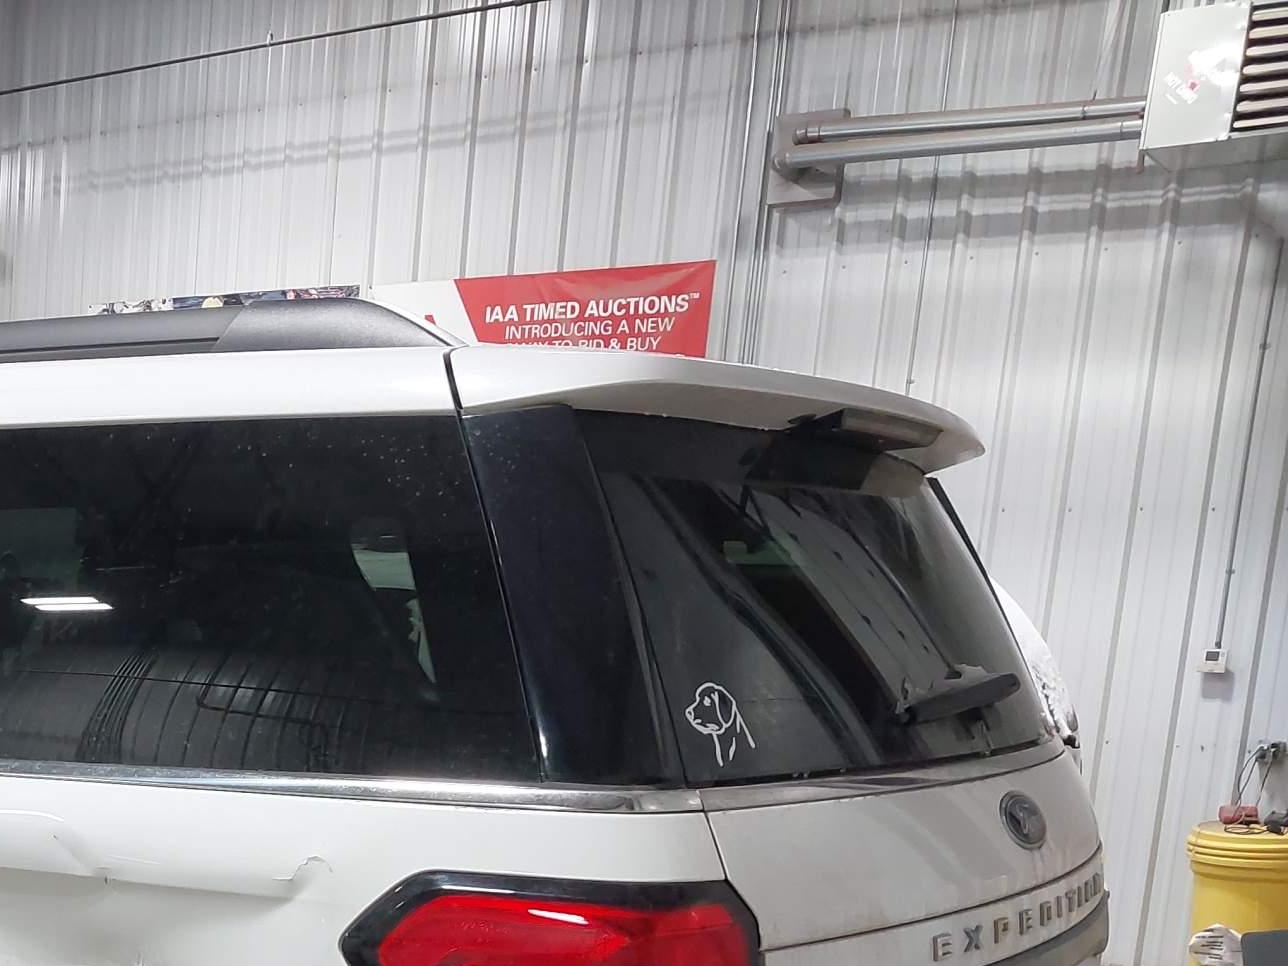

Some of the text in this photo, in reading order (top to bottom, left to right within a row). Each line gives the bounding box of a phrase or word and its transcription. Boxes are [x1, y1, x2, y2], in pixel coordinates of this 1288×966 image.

[485, 304, 519, 324] IAA
[522, 300, 581, 321] TIMED
[504, 317, 675, 341] INTRODUCING A NEW
[608, 337, 621, 349] &
[626, 336, 662, 351] BUY
